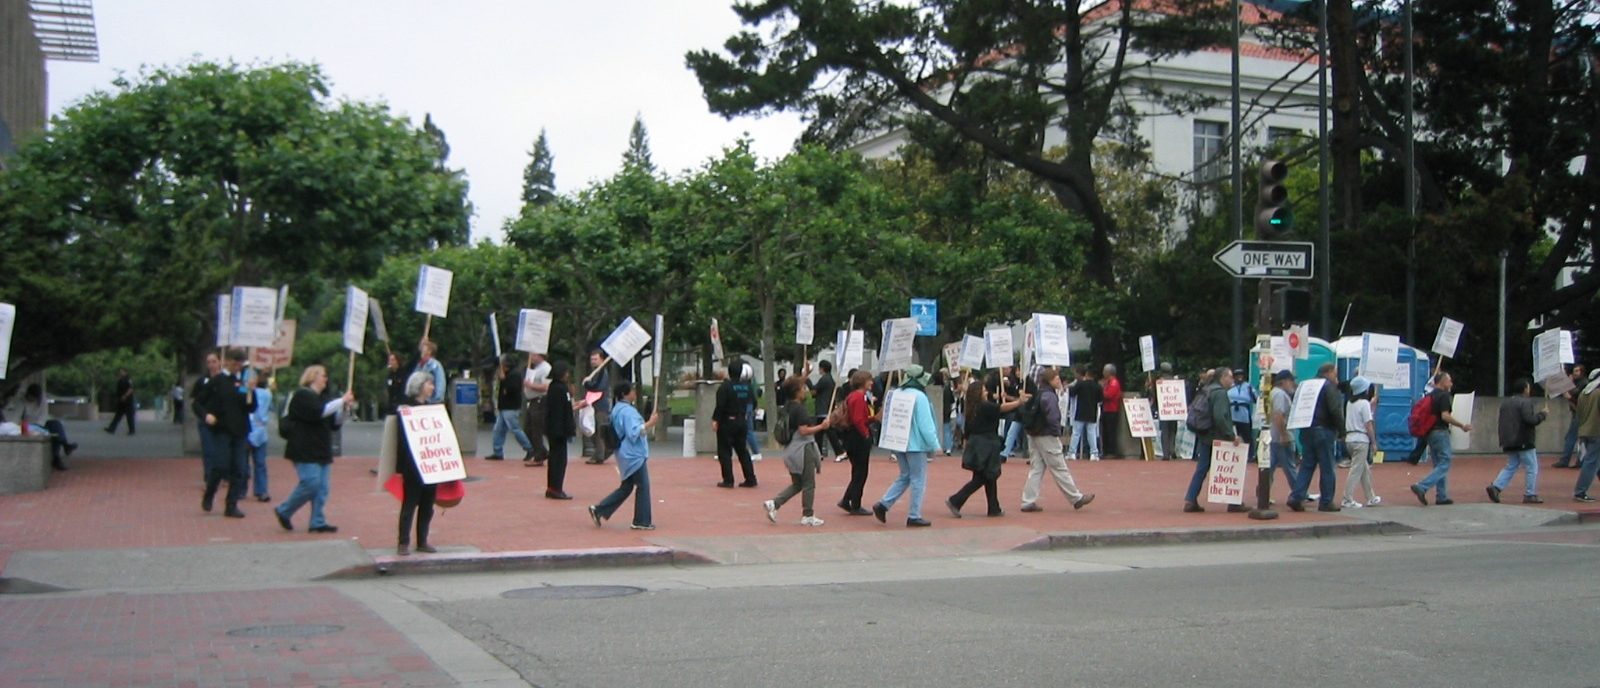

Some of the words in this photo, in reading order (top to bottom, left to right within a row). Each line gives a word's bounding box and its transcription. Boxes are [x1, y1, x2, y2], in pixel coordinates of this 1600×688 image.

[1243, 252, 1269, 266] ONE
[1274, 253, 1302, 266] WAY
[409, 417, 431, 432] UC
[432, 417, 443, 430] is
[420, 433, 441, 446] not
[420, 446, 453, 460] above
[1216, 450, 1231, 462] UC
[1231, 452, 1240, 463] is
[420, 461, 438, 474] the
[440, 459, 460, 471] law
[1216, 464, 1234, 473] not
[1213, 473, 1238, 485] above
[1210, 484, 1224, 496] the
[1225, 485, 1241, 497] law
